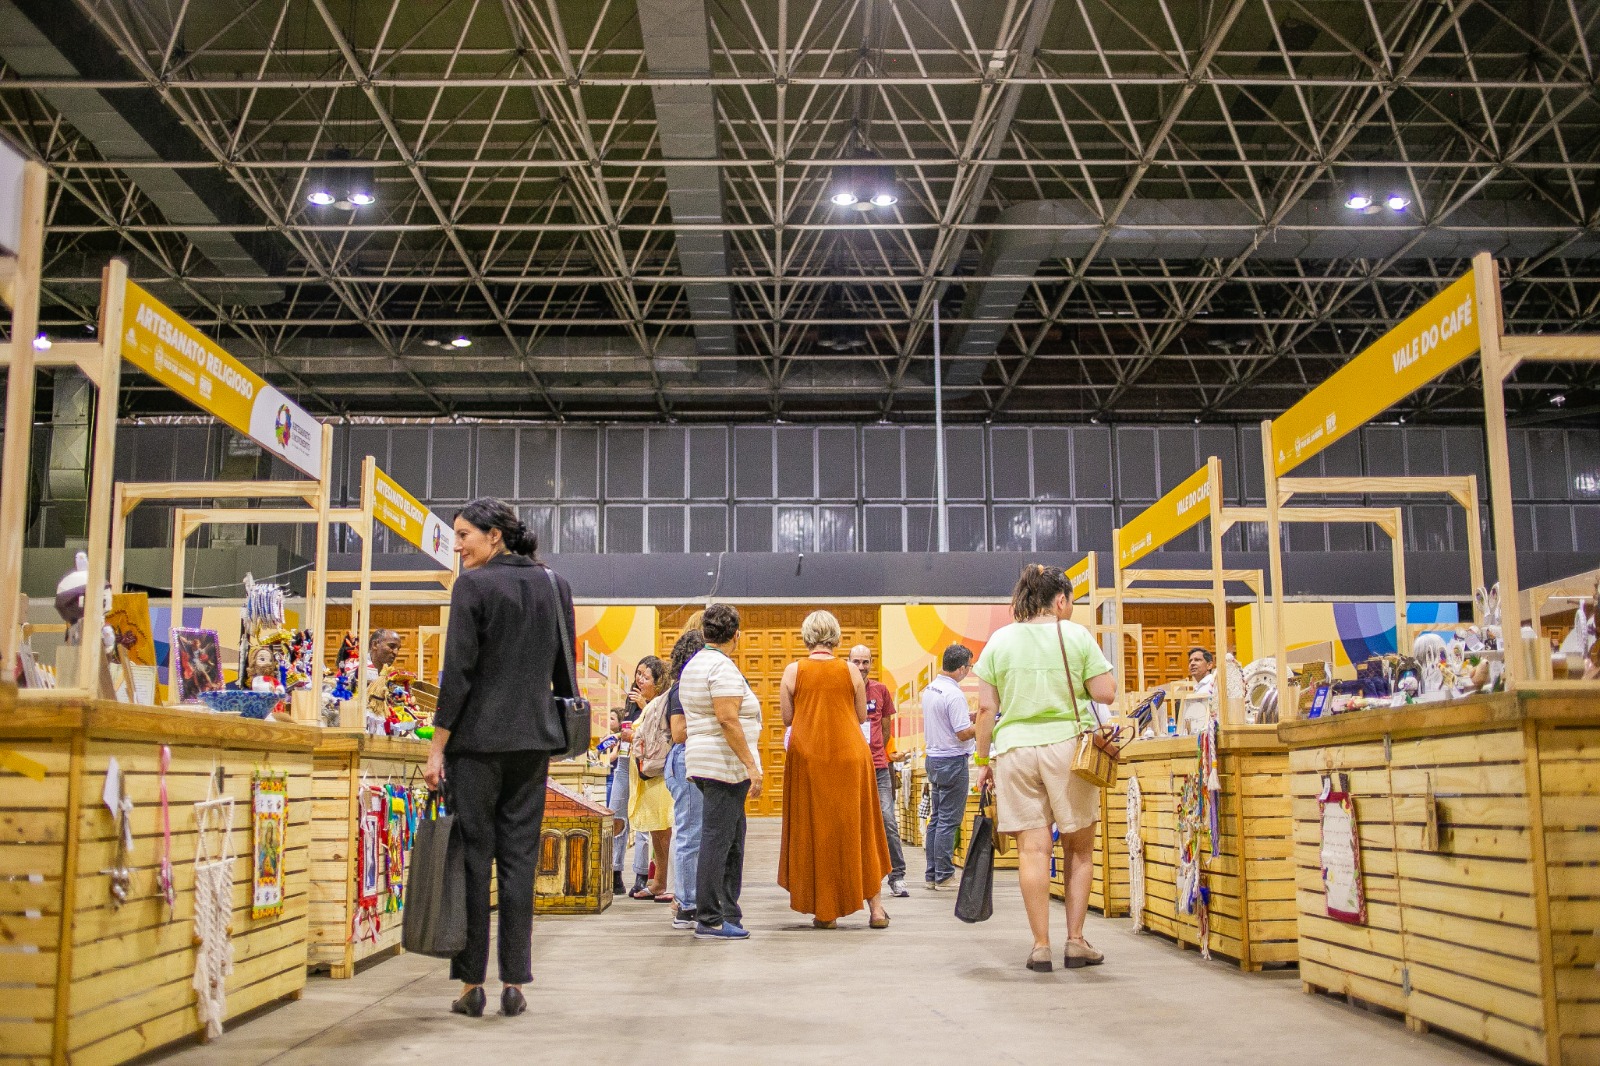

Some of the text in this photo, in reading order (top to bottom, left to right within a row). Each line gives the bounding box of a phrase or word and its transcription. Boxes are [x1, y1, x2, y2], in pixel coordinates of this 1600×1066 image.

[136, 303, 206, 366] ARTESANATO
[206, 351, 253, 400] RELIGIOSO
[1392, 293, 1472, 374] VALE DO CAFÉ
[376, 478, 404, 509] ARTESANATO
[1176, 496, 1188, 517] VALE
[1189, 490, 1197, 509] DO
